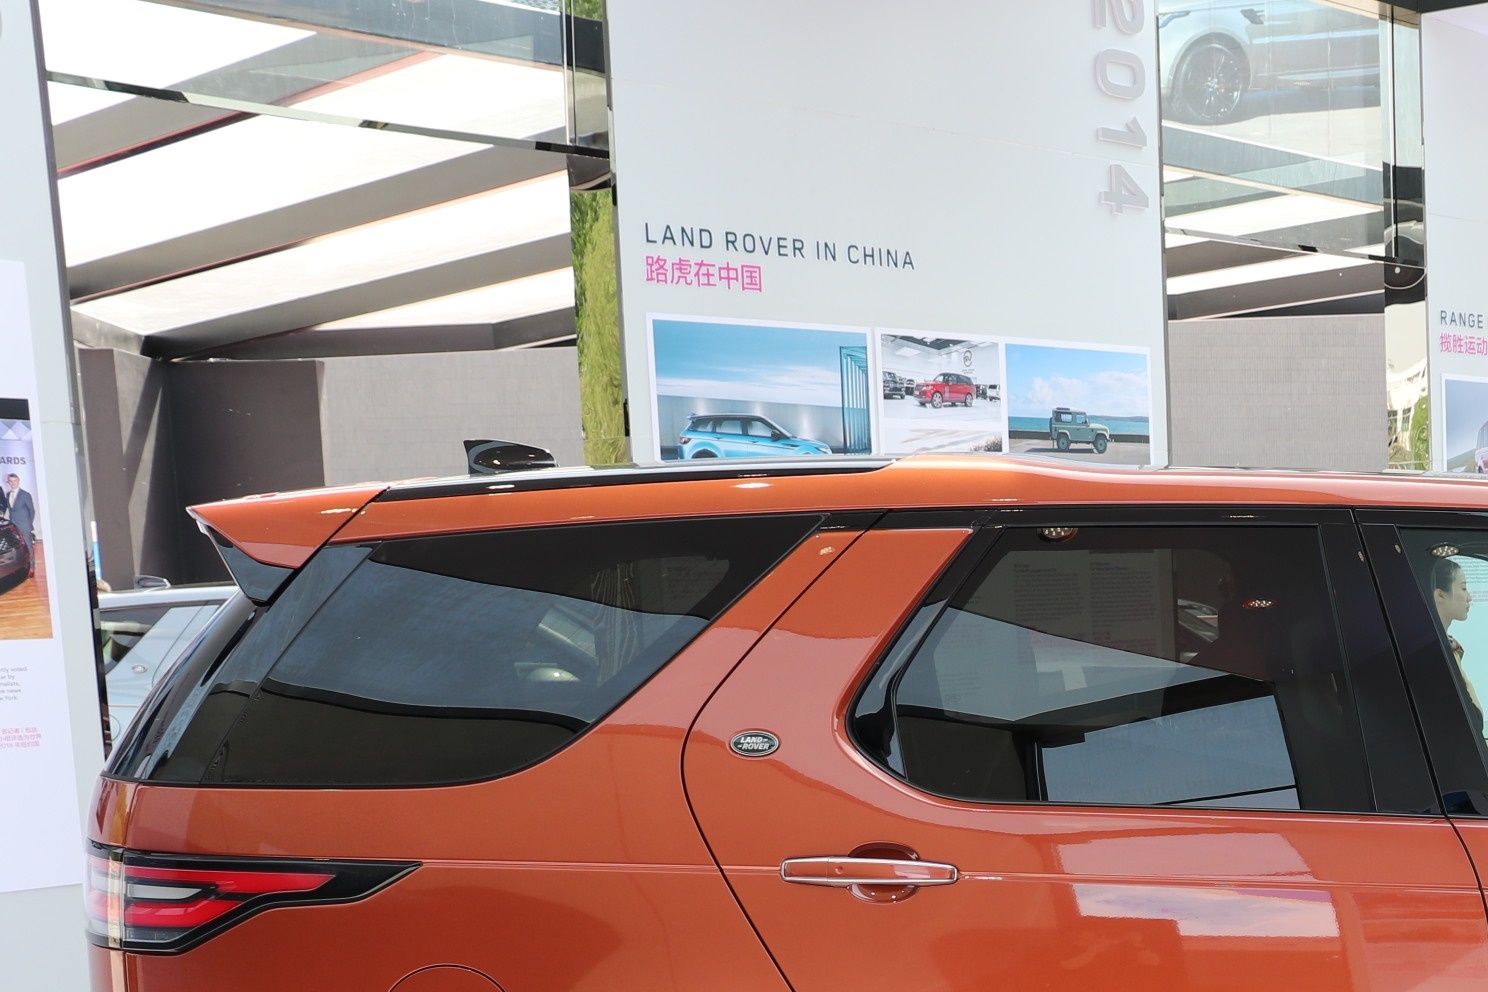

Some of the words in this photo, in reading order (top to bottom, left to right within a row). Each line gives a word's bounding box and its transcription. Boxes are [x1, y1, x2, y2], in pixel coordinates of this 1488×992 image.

[1092, 0, 1150, 215] 2014
[644, 221, 713, 249] LAND
[724, 230, 806, 259] ROVER
[815, 240, 837, 262] IN
[847, 244, 915, 271] CHINA
[644, 255, 763, 293] 路虎在中国
[1440, 310, 1484, 329] RANGE
[740, 736, 763, 744] LAND
